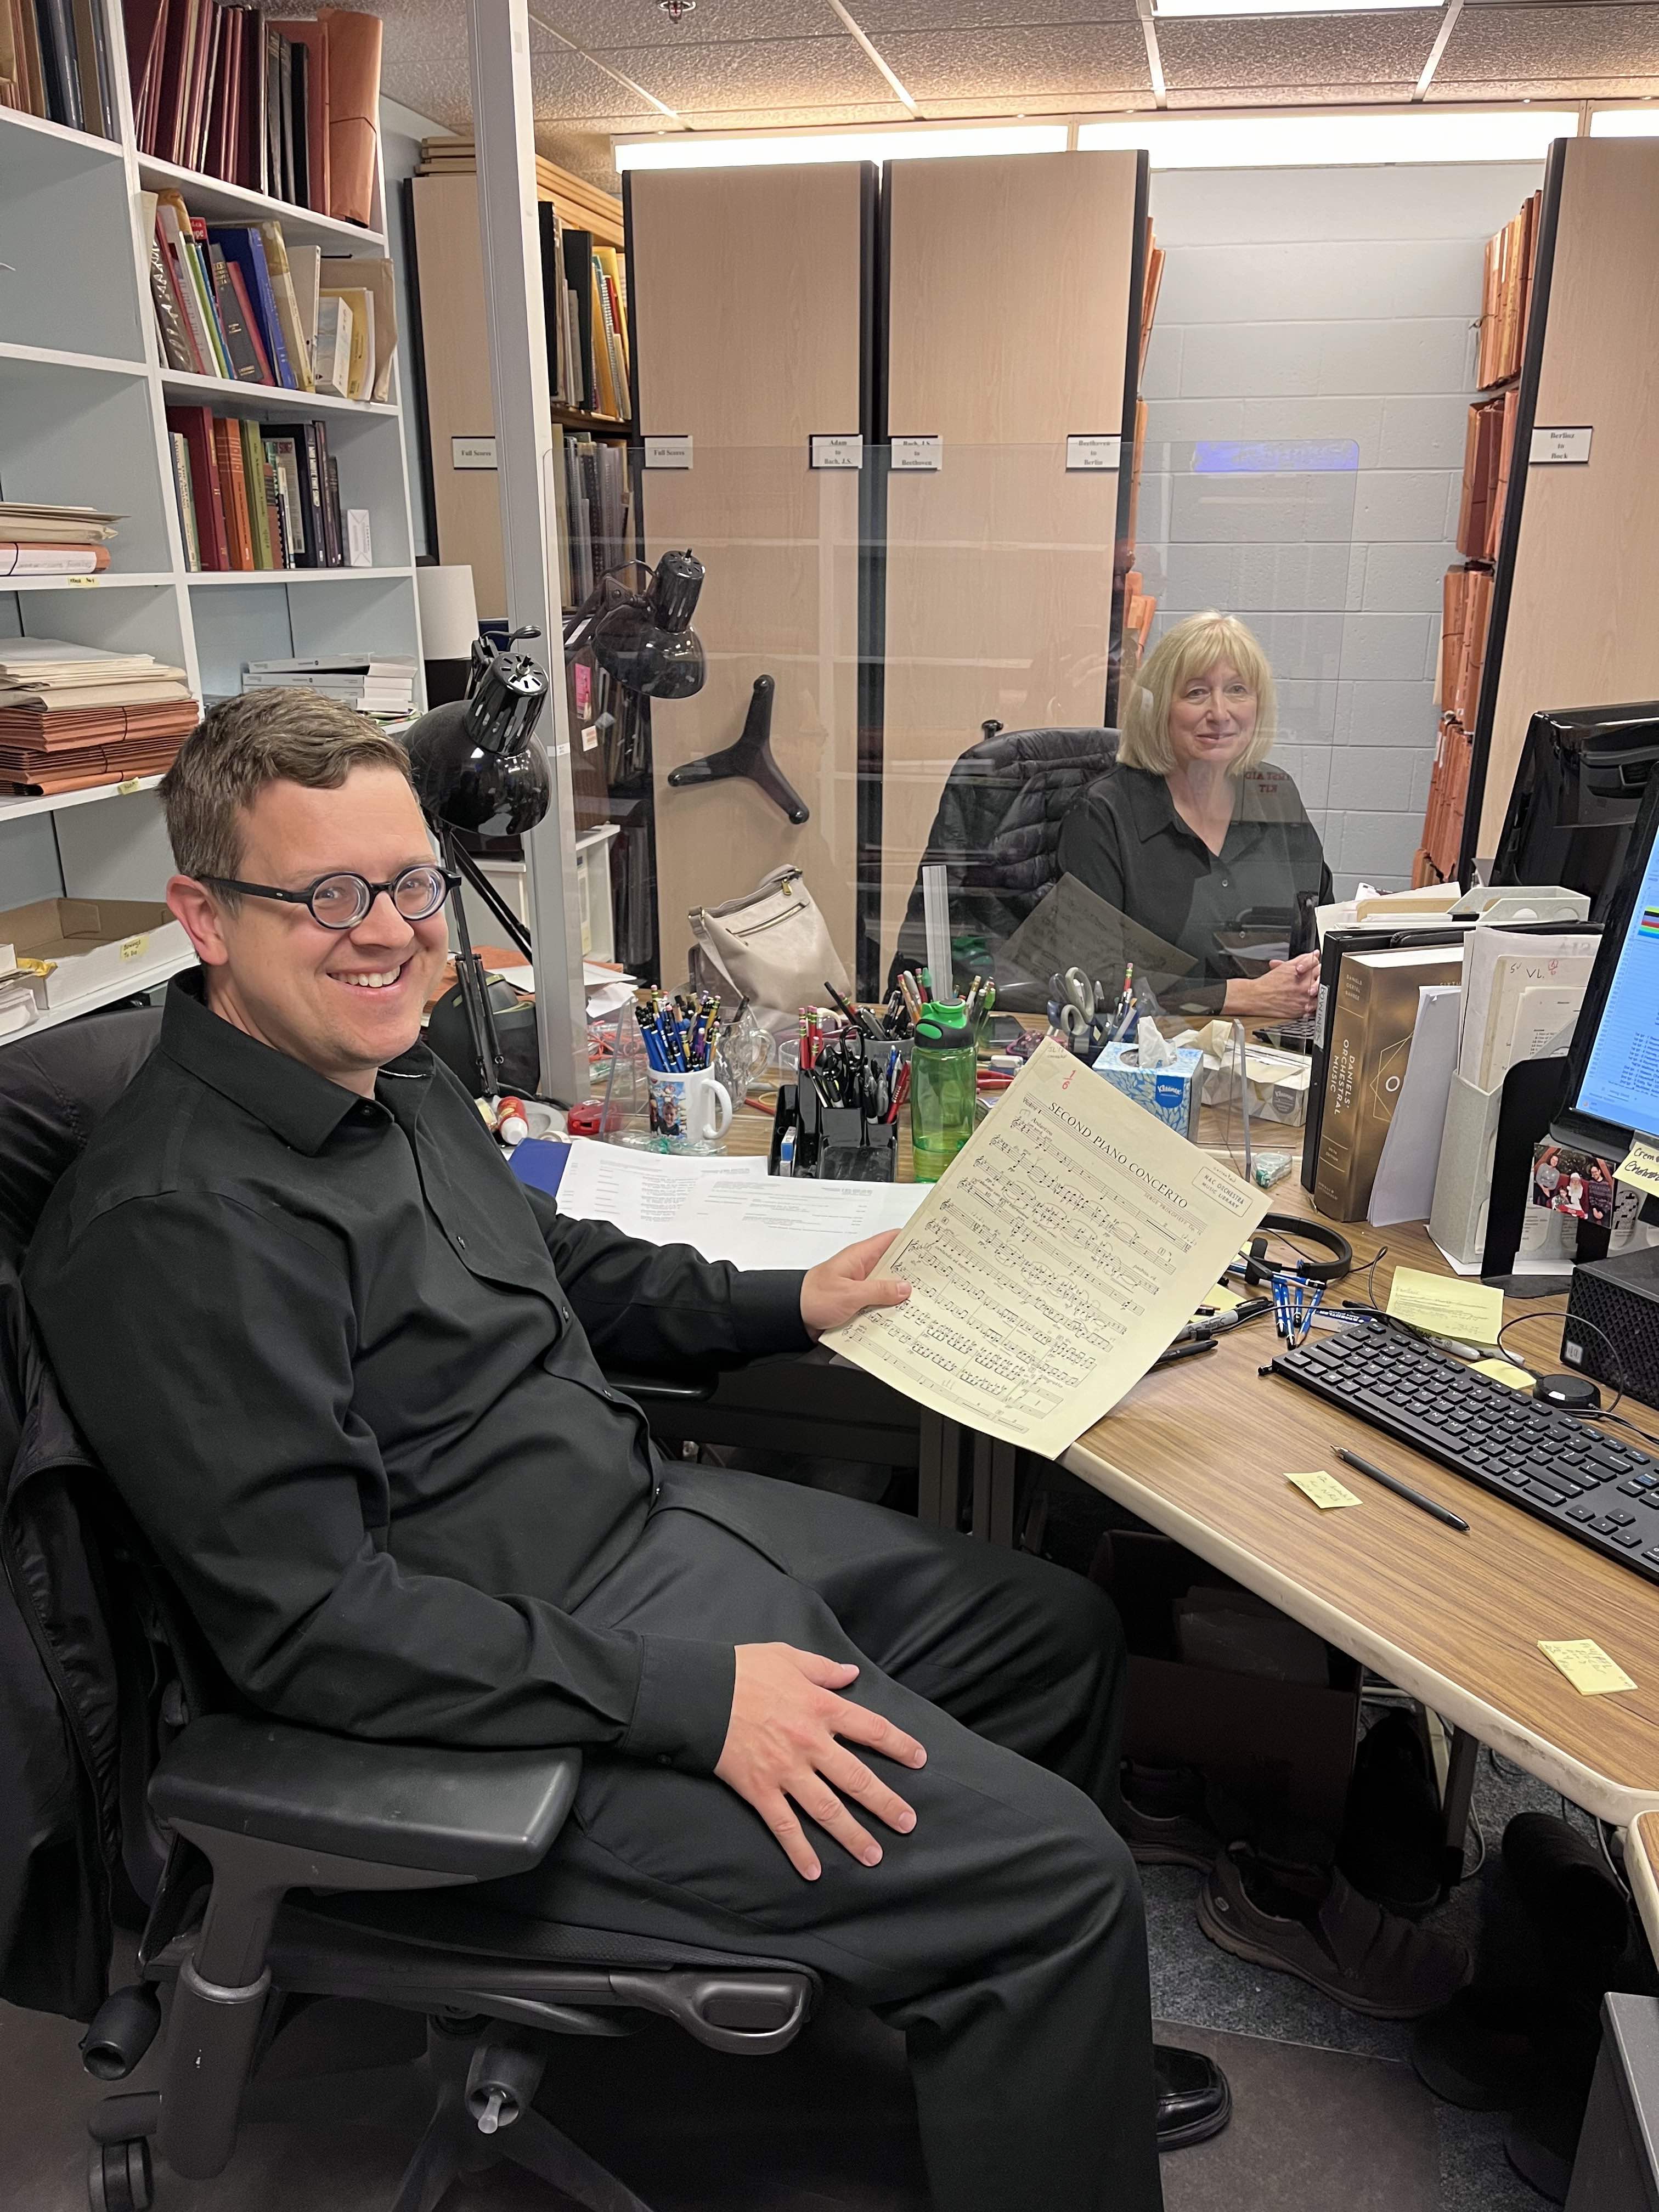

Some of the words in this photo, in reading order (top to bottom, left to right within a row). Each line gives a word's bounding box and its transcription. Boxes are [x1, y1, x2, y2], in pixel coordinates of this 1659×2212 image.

[1158, 1085, 1182, 1095] Kleenex
[1330, 1055, 1339, 1093] MUSIC
[1334, 1039, 1349, 1115] ORCHESTRAL
[1344, 1056, 1355, 1109] DANIELS'
[1049, 1102, 1092, 1137] SECOND
[1093, 1136, 1127, 1164] PIANO
[1129, 1163, 1188, 1208] CONCERTO
[1202, 1182, 1217, 1194] MUSIC
[1218, 1193, 1239, 1209] LIBRARY
[1204, 1174, 1216, 1186] NAC
[1217, 1183, 1245, 1205] ORCHESTRA
